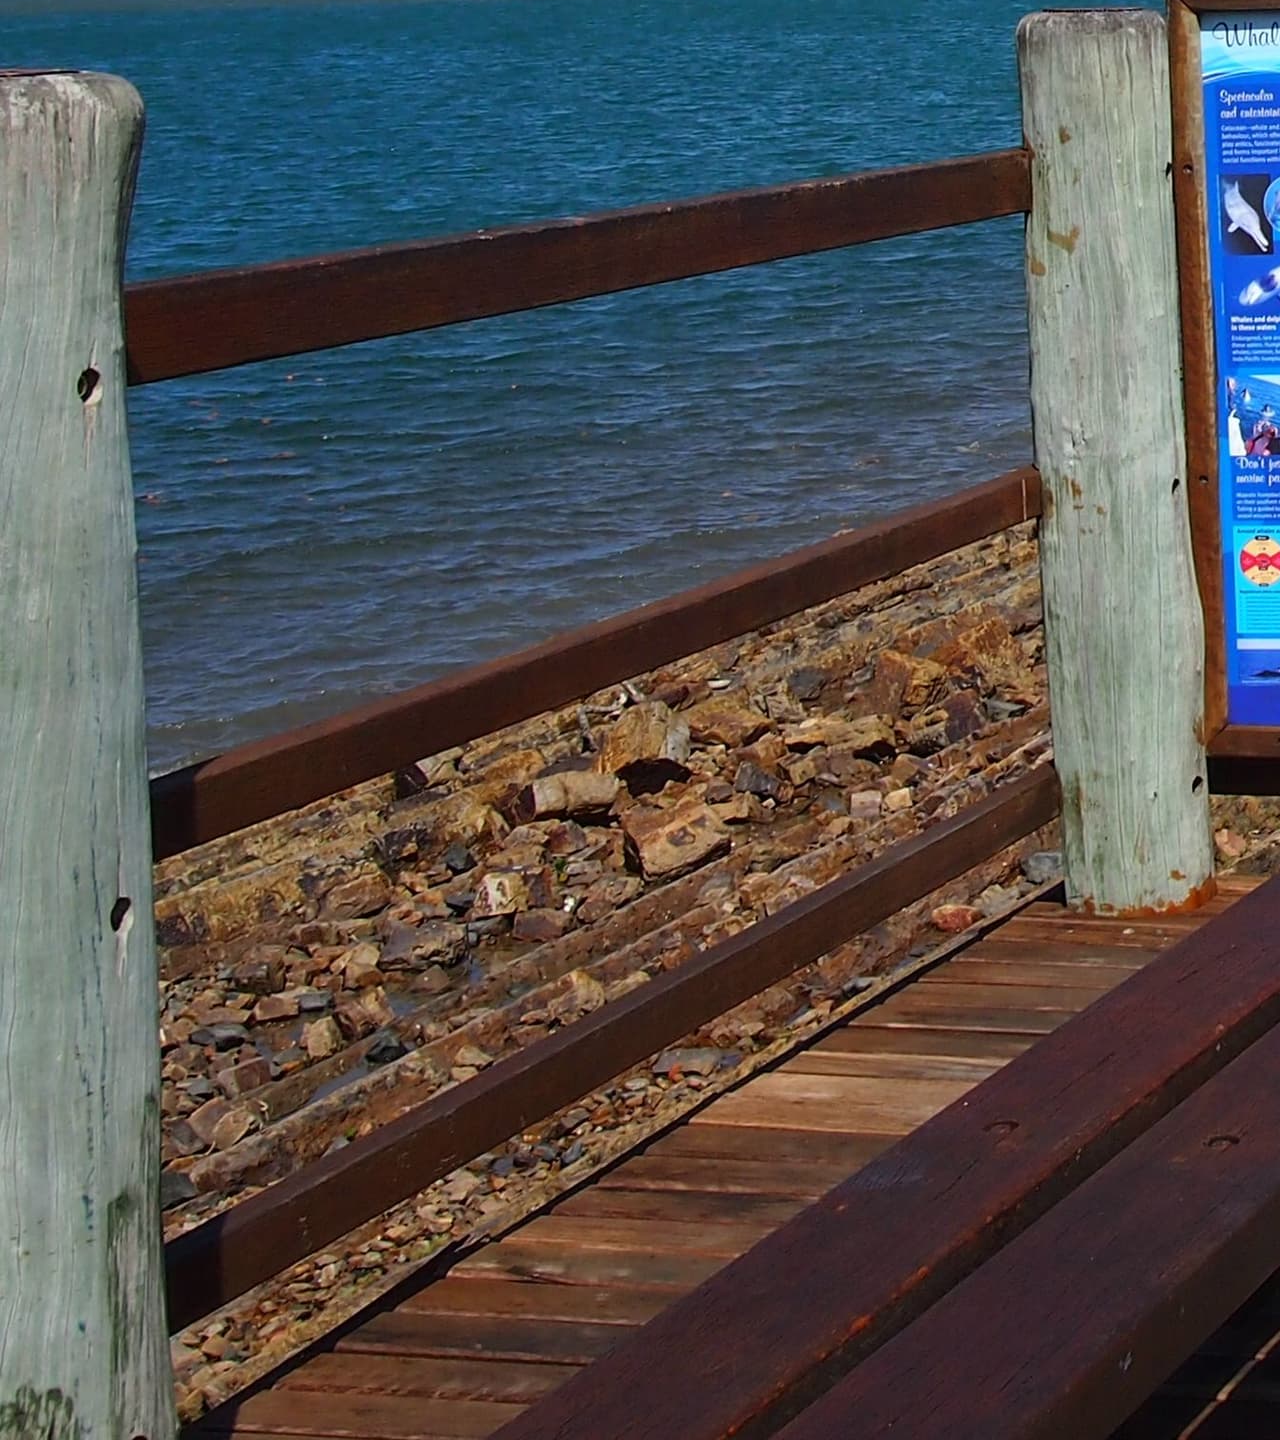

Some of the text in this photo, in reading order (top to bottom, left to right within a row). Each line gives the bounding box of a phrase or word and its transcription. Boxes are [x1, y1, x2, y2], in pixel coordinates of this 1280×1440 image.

[1220, 88, 1274, 106] Spectacular
[1220, 106, 1237, 118] and
[1231, 315, 1253, 323] Whales
[1254, 315, 1266, 323] and
[1235, 456, 1265, 469] Don't
[1236, 473, 1265, 483] marine
